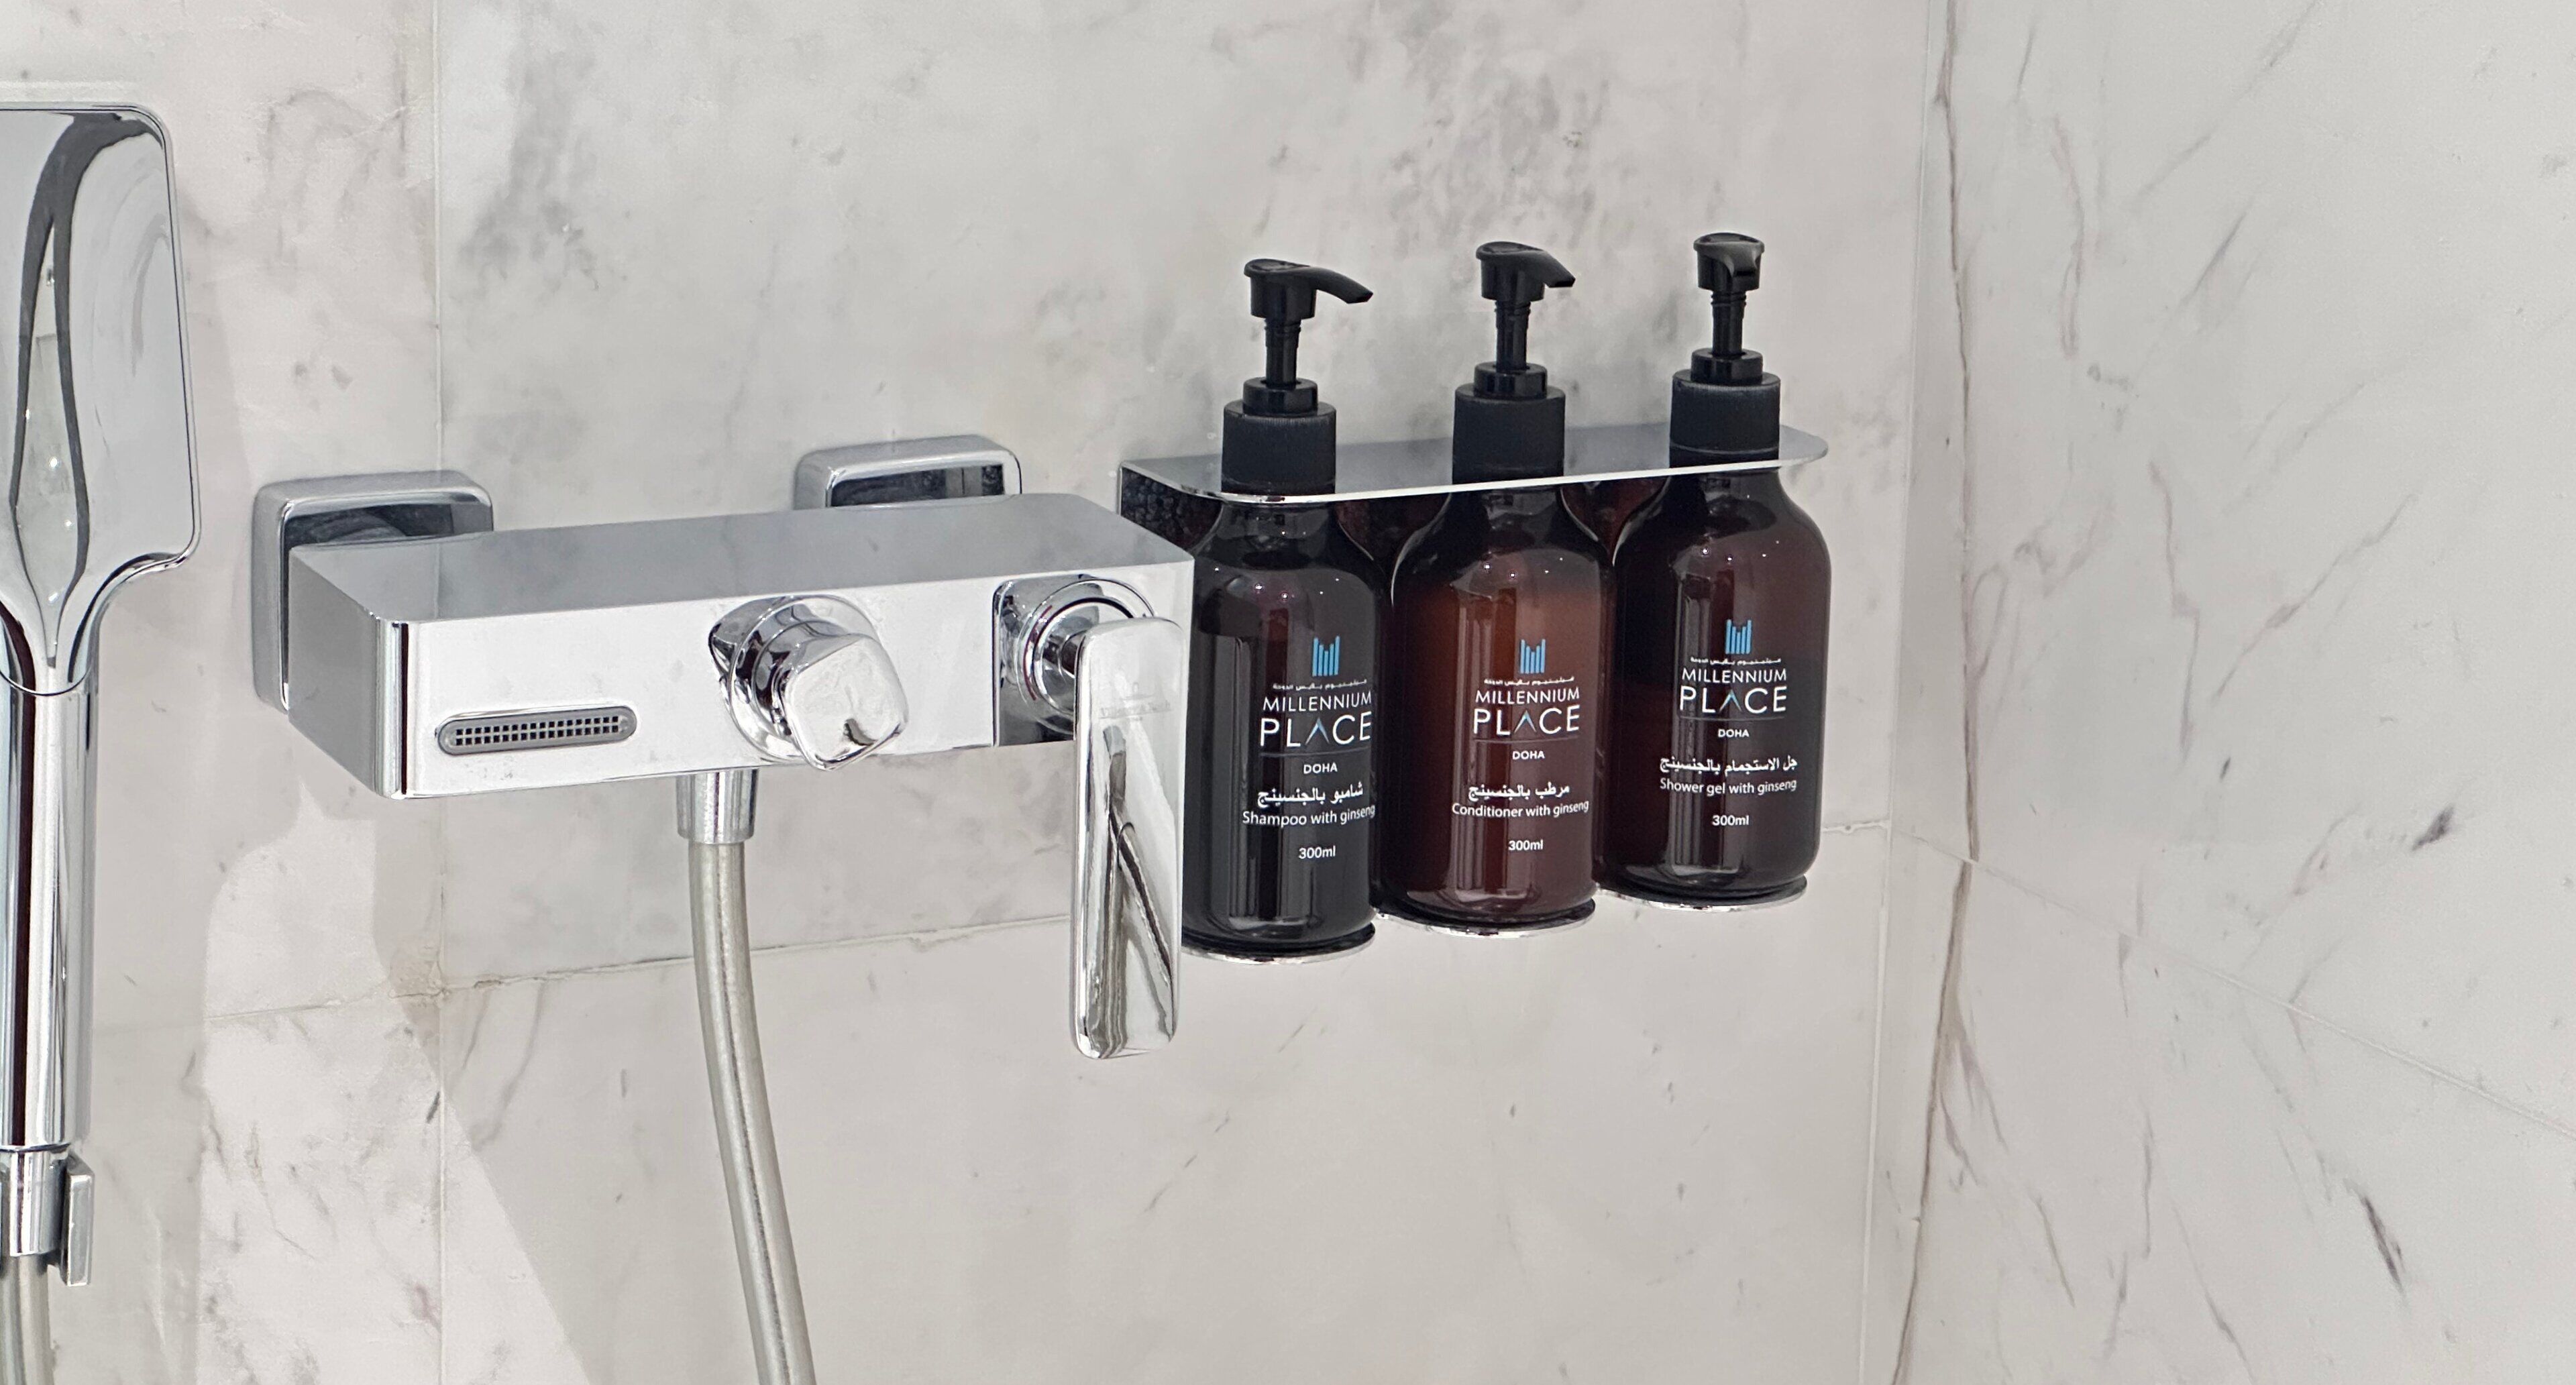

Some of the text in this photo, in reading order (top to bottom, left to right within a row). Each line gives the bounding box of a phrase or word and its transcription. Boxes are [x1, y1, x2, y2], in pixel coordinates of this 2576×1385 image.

[1682, 667, 1786, 684] MILLENNIUM
[1263, 690, 1371, 712] MILLENNIUM
[1475, 687, 1580, 704] MILLENNIUM
[1679, 685, 1787, 714] PLACE
[1260, 711, 1372, 747] PLACE
[1473, 704, 1580, 736] PLACE
[1717, 728, 1750, 738] DOHA
[1512, 750, 1546, 761] DOHA
[1303, 762, 1338, 775] DOHA
[1660, 755, 1798, 777] جل الاستجمام بالجنسينج
[1257, 781, 1363, 809] شامبو بالجنسينج
[1468, 781, 1570, 802] مرطب بالجنسينج
[1660, 777, 1797, 797] Shower gel with ginseng
[1242, 805, 1375, 828] Shampoo with ginseng
[1452, 800, 1589, 818] Conditioner with ginseng
[1712, 814, 1750, 826] 300ml
[1298, 845, 1336, 859] 300ml
[1508, 838, 1544, 851] 300ml
